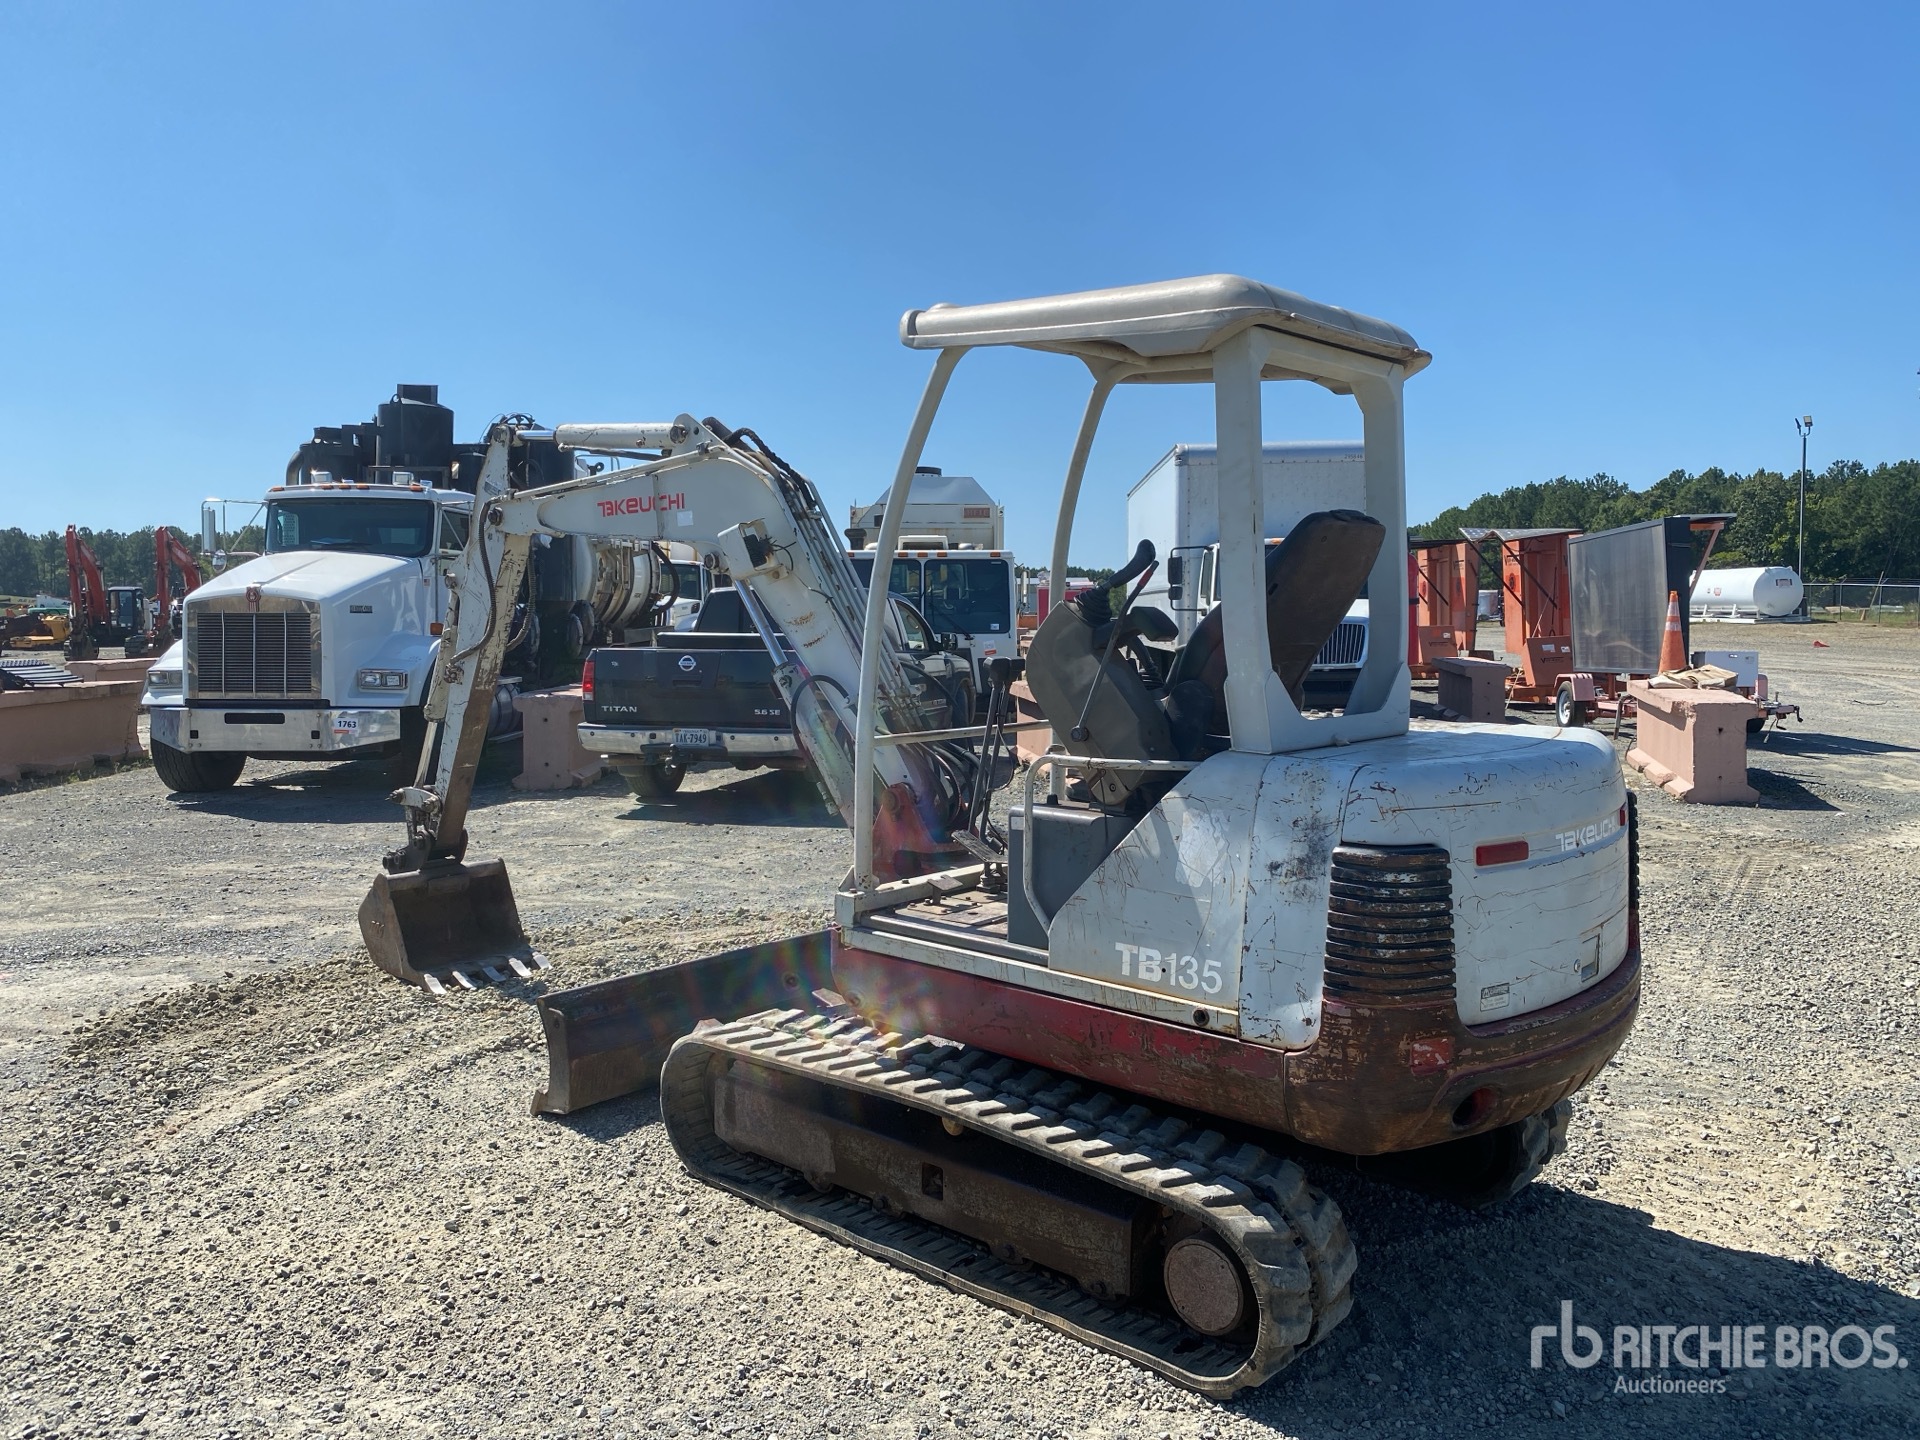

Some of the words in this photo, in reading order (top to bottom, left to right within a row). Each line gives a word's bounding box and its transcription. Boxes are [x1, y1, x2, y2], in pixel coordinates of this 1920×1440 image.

[601, 705, 637, 713] TITAN
[337, 720, 357, 729] 1763
[675, 733, 707, 744] TAK-7949
